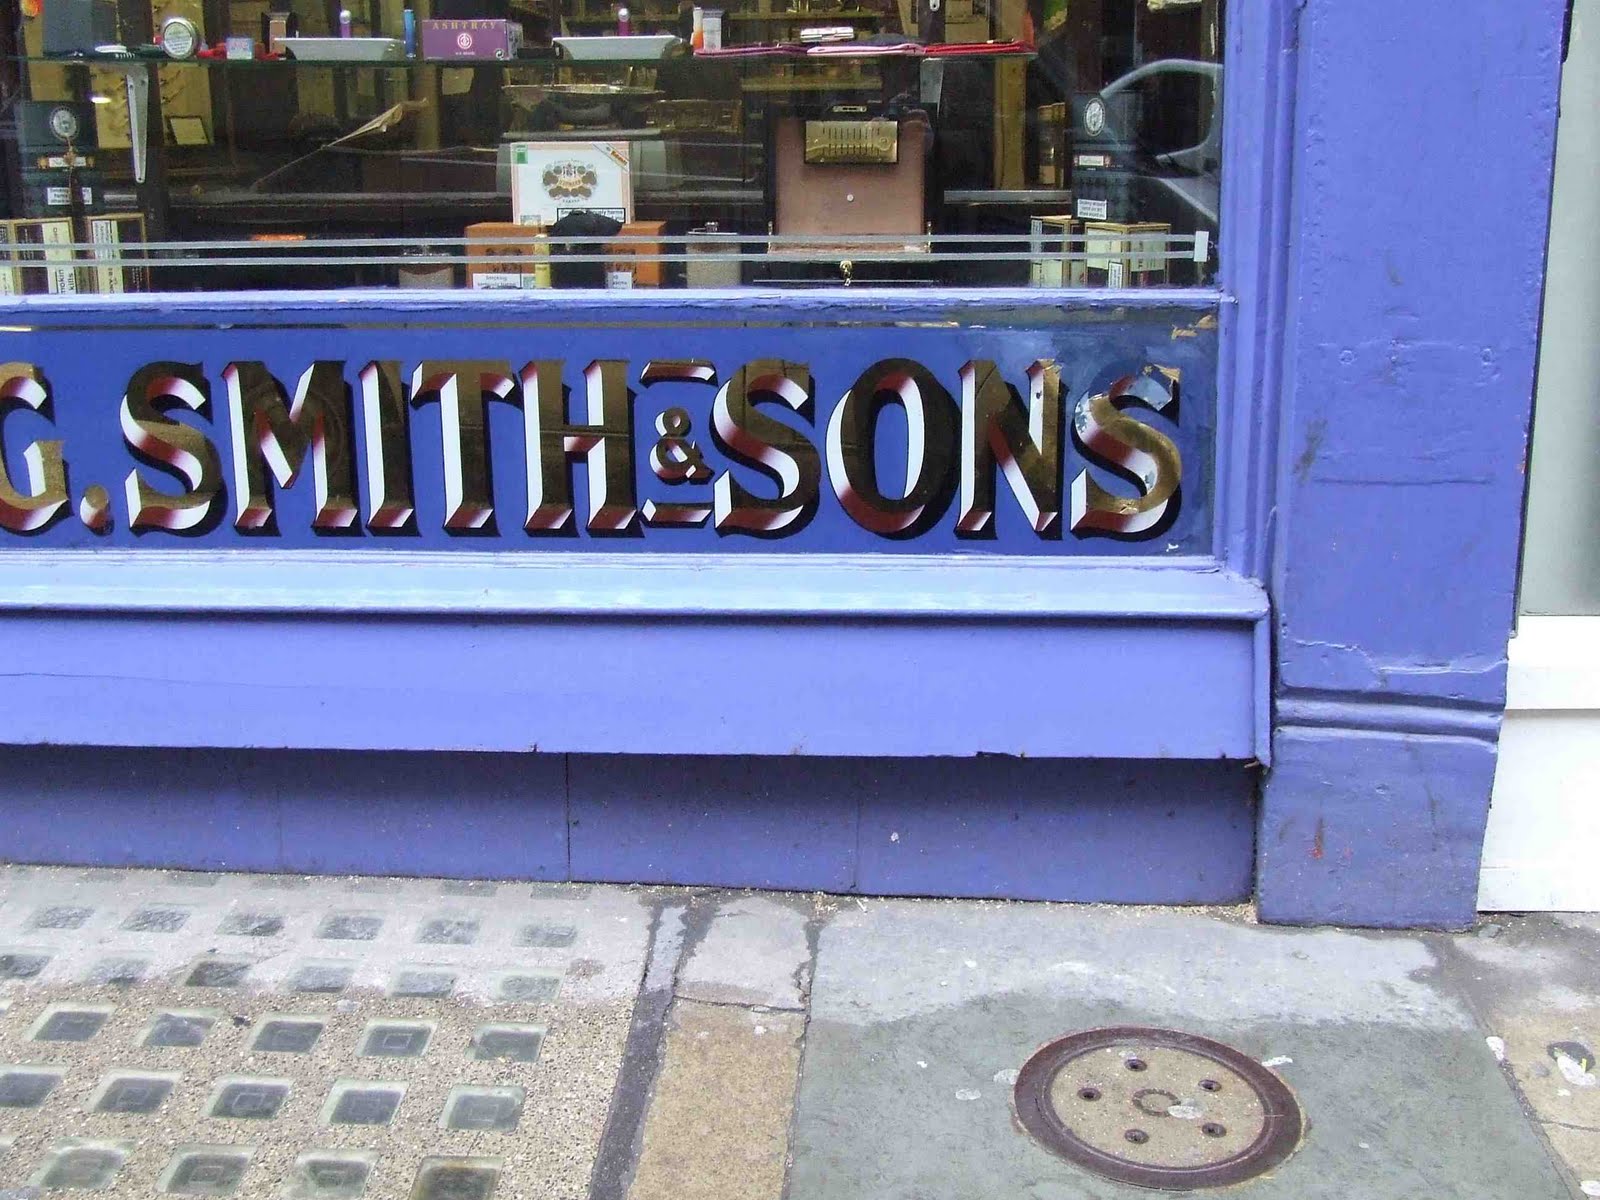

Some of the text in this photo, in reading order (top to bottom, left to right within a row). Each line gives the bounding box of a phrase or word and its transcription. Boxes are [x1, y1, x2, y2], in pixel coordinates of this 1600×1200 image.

[432, 21, 497, 30] ASHTRAY
[120, 358, 637, 537] SMITH
[709, 357, 1182, 540] SONS
